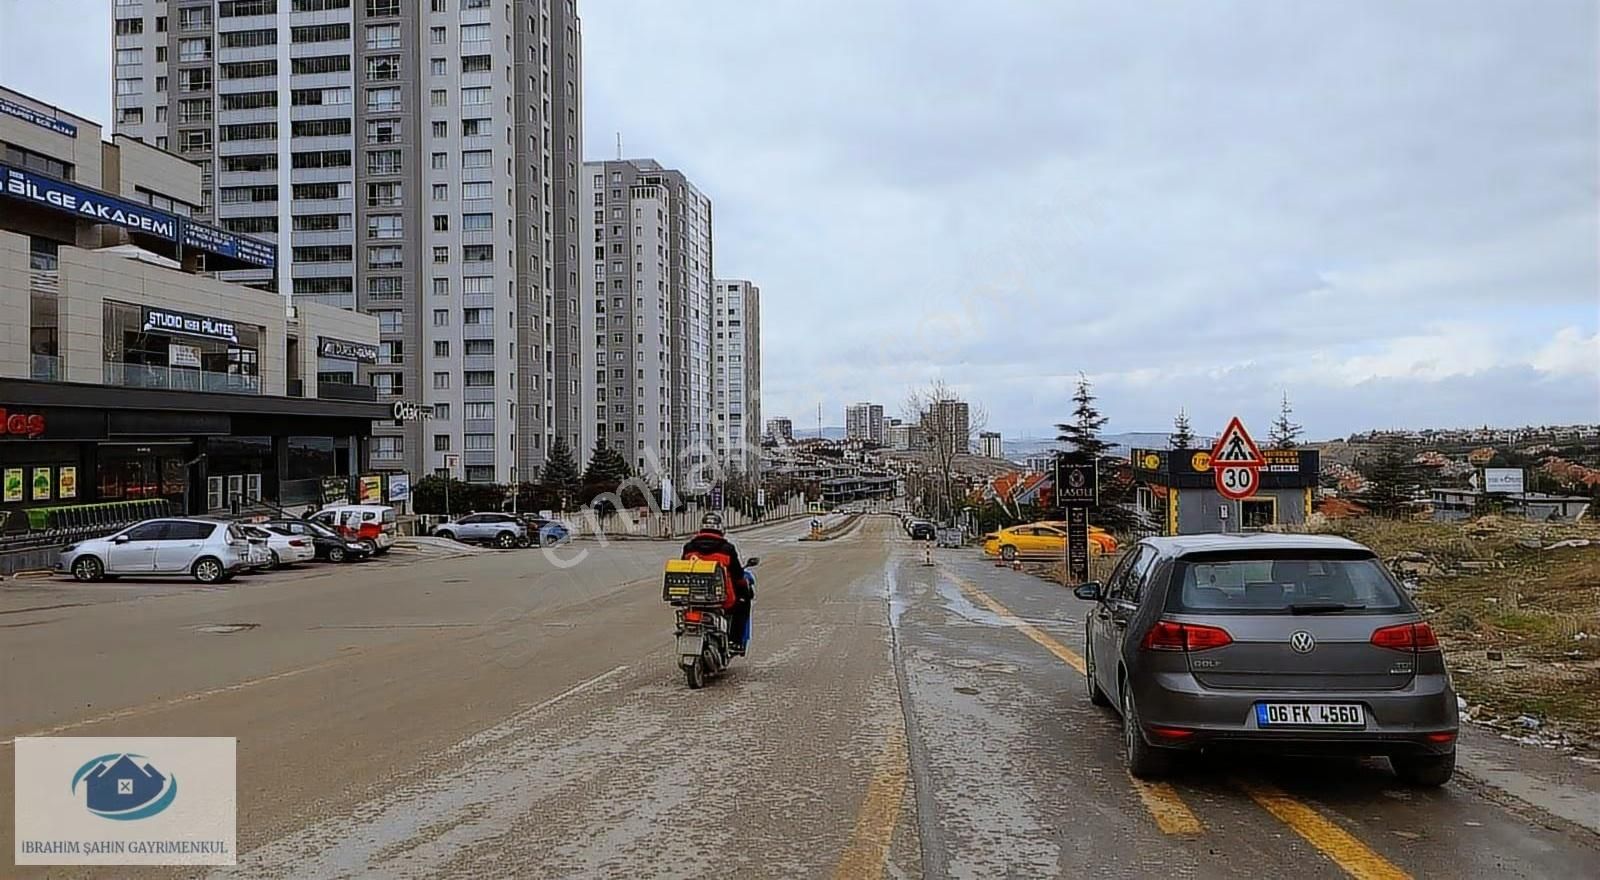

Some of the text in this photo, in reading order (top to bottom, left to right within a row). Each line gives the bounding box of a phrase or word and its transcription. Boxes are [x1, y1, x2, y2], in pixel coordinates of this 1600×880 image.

[79, 200, 173, 238] AKADEMİ
[149, 311, 183, 330] STUDIO
[1225, 468, 1250, 488] 30
[1268, 705, 1289, 722] 06
[1292, 705, 1313, 723] FK
[1320, 705, 1360, 723] 4560
